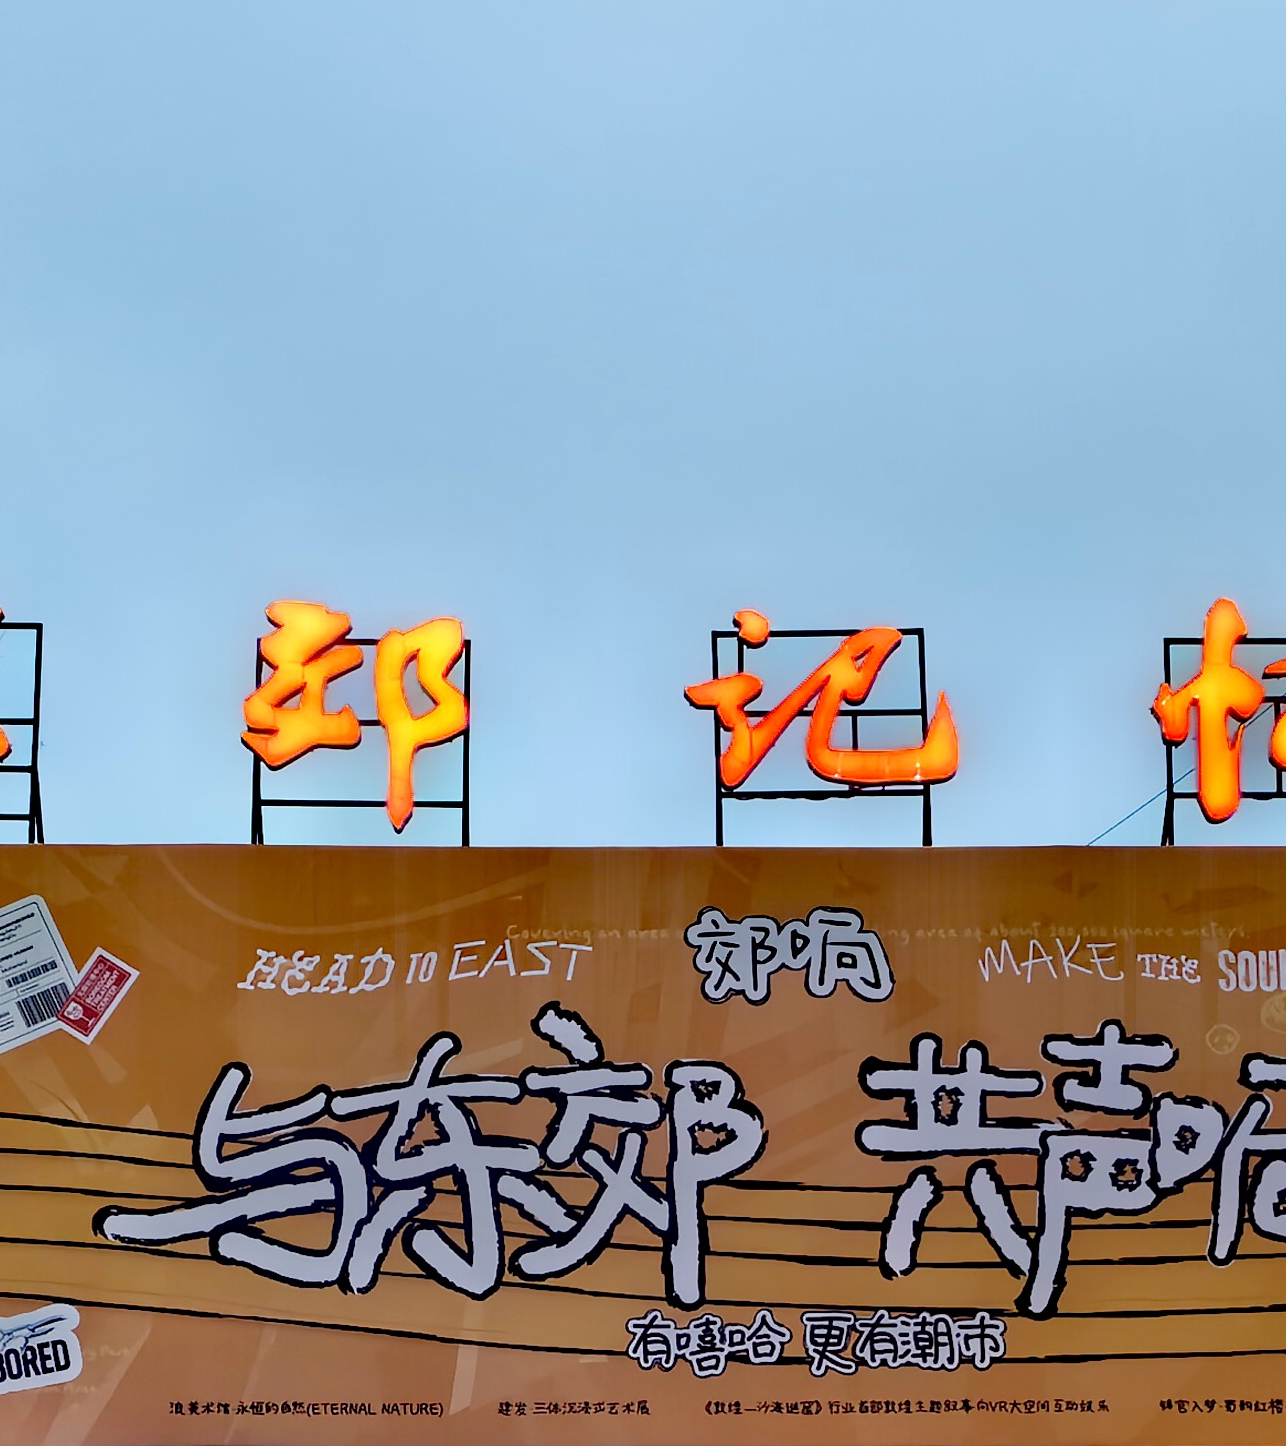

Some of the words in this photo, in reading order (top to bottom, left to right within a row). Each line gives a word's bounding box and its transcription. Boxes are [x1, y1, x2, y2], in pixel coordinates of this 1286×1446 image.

[237, 946, 394, 996] HEAD
[449, 938, 594, 982] EAST
[686, 905, 895, 1004] 郊响
[978, 934, 1124, 984] MAKE
[92, 1001, 768, 1307] 与东郊
[625, 1309, 793, 1377] 有嘻哈
[381, 1402, 444, 1417] NATURE)
